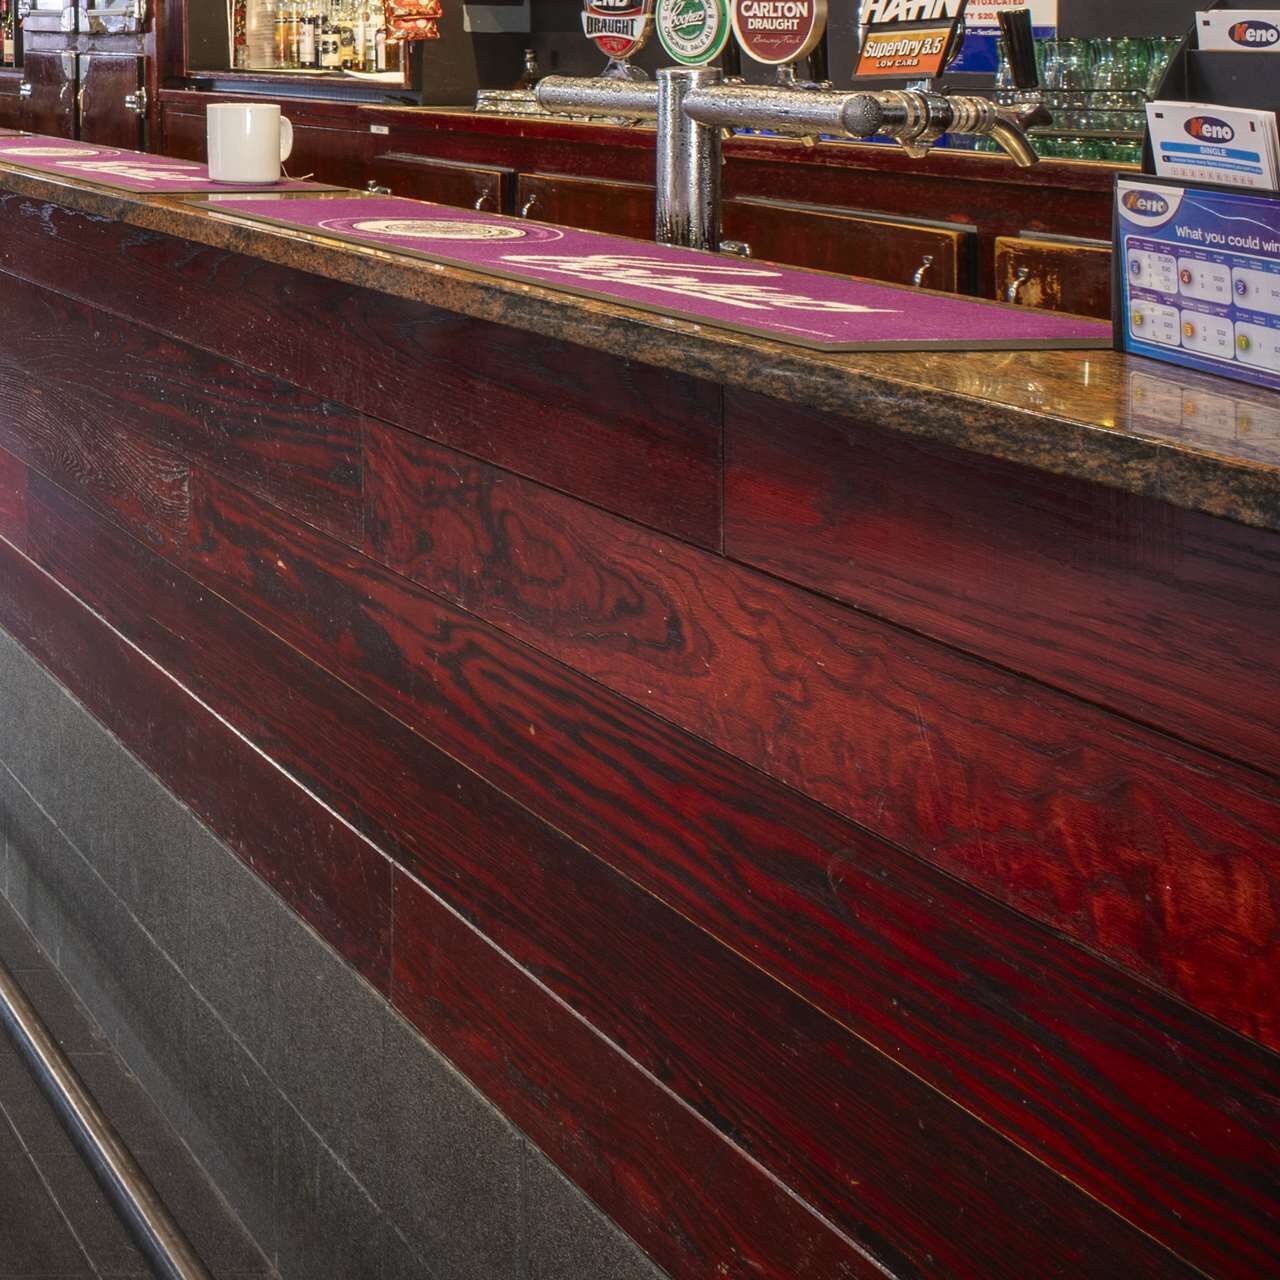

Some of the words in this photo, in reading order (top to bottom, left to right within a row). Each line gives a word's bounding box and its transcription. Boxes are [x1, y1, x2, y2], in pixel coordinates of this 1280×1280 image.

[740, 1, 808, 17] CARLTON
[977, 12, 997, 22] $20,
[586, 16, 635, 37] DRAUGHT
[748, 19, 799, 31] DRAUGHT
[1235, 23, 1279, 43] Keno
[864, 39, 923, 58] SuperDry
[922, 37, 943, 55] 3.5
[875, 59, 895, 67] LOW
[896, 59, 919, 67] CARB
[1190, 118, 1233, 140] Keno
[1199, 146, 1227, 157] SINGLE
[1127, 192, 1167, 213] Keno
[1176, 225, 1203, 241] What
[1205, 232, 1226, 245] you
[1228, 235, 1260, 249] could
